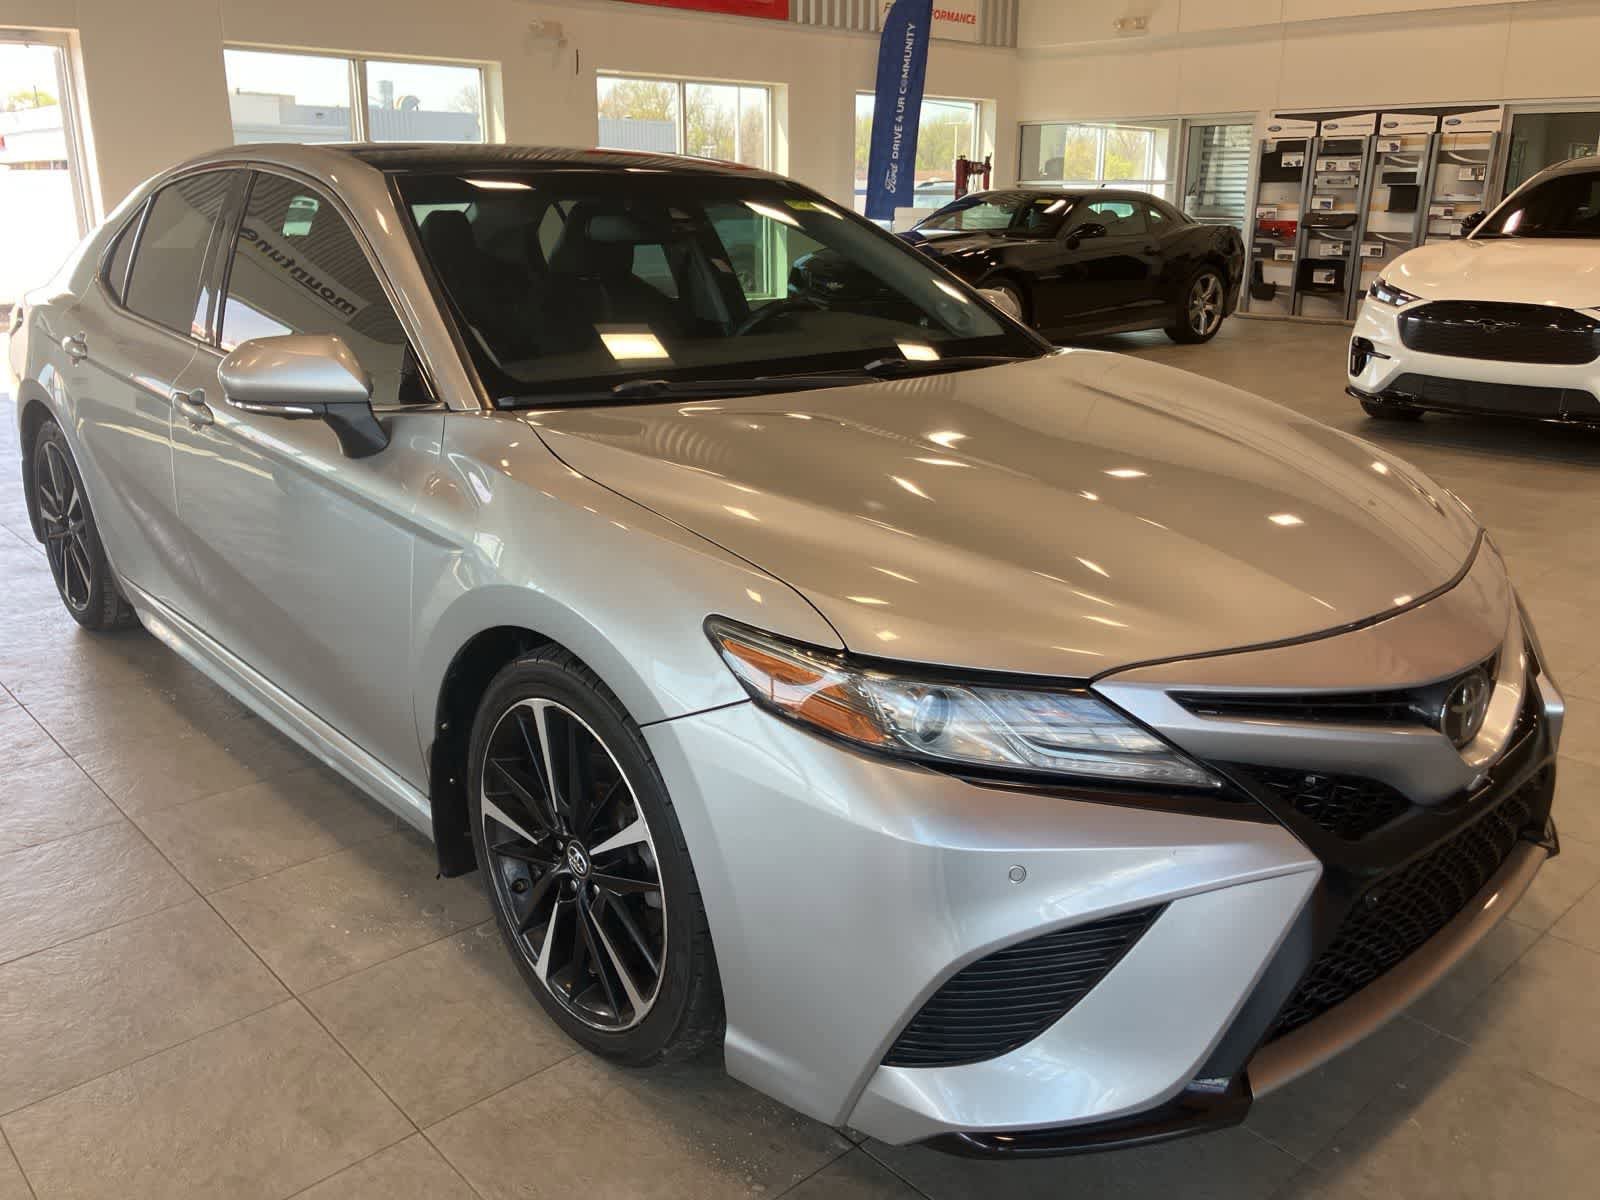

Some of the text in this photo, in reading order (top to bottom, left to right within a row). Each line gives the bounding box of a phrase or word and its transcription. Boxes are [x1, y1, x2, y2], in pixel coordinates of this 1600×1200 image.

[899, 23, 916, 94] COMMUNITY
[896, 98, 905, 113] UR
[892, 124, 903, 160] DRIVE
[884, 162, 898, 194] Ford
